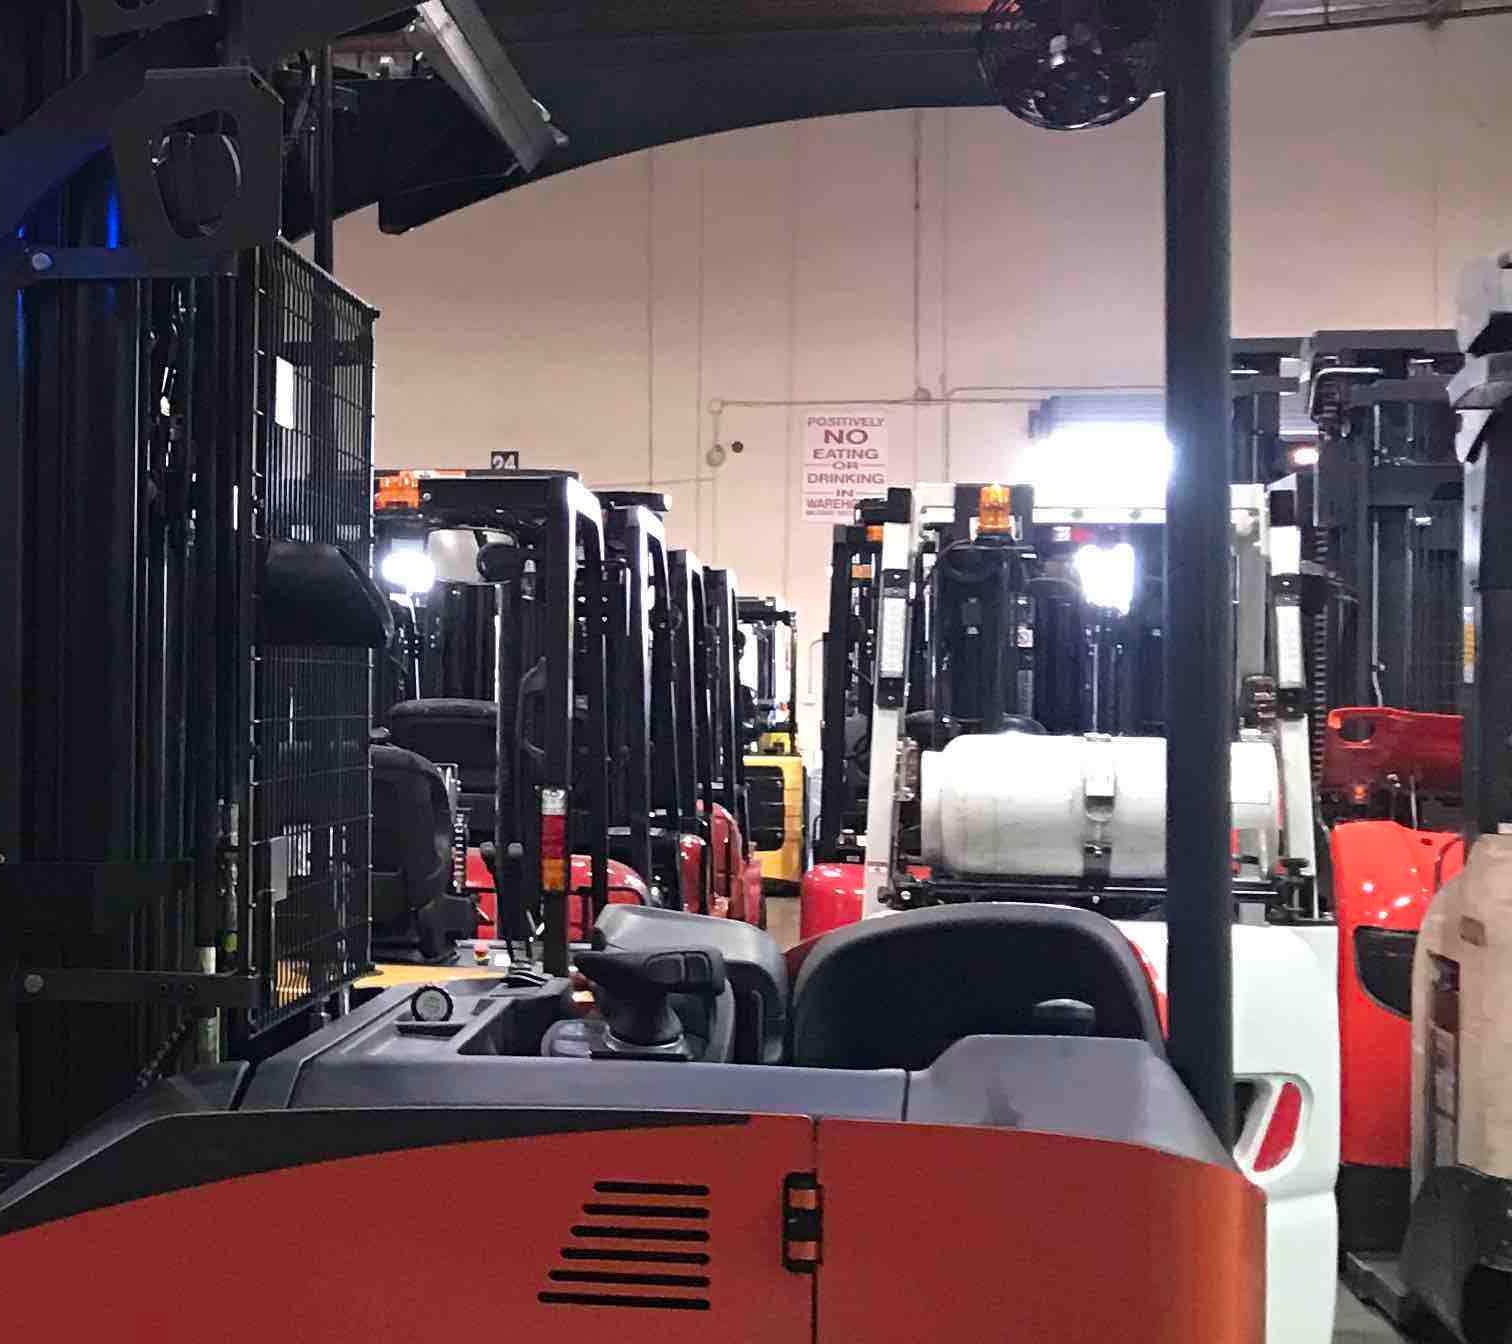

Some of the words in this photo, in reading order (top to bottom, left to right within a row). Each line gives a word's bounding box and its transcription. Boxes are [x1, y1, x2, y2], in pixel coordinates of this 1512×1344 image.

[807, 416, 885, 427] POSITIVELY
[824, 429, 868, 445] NO
[813, 448, 879, 460] EATING
[807, 473, 885, 484] DRINKING
[836, 489, 854, 497] IN
[807, 498, 857, 509] WAREHO
